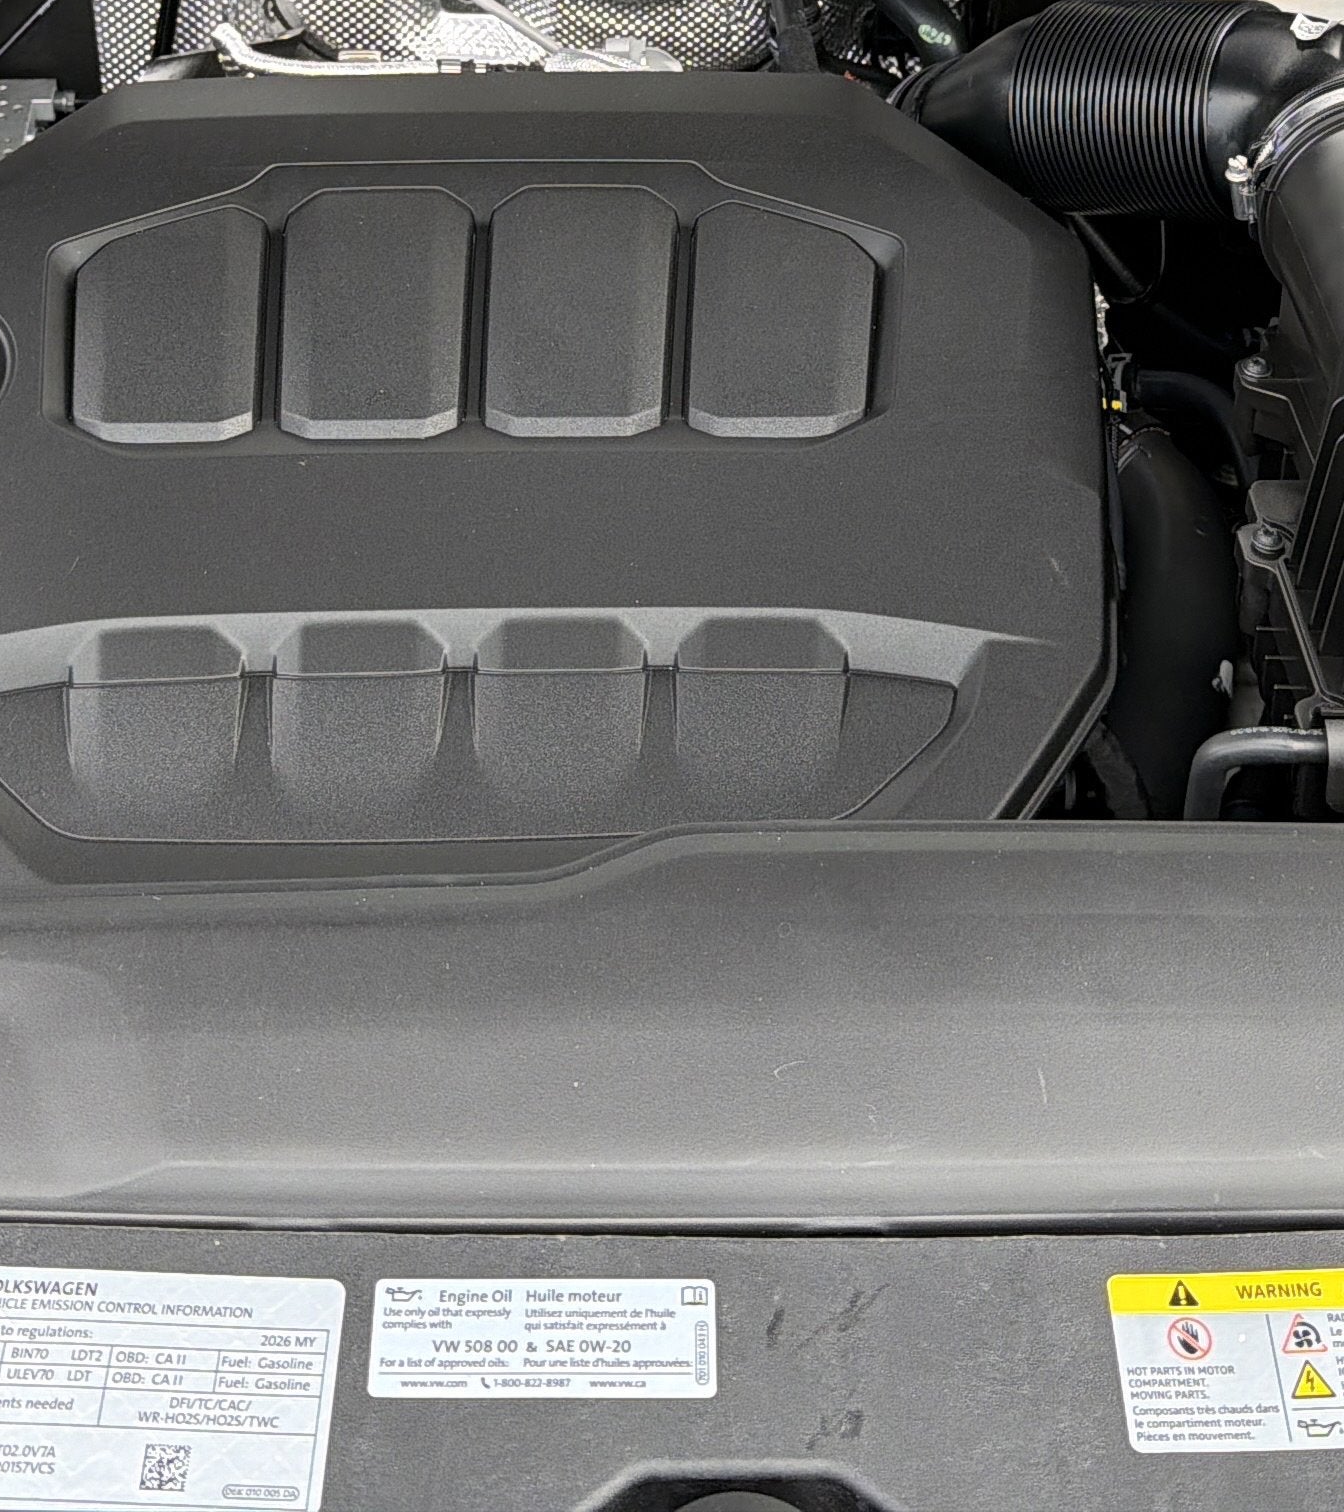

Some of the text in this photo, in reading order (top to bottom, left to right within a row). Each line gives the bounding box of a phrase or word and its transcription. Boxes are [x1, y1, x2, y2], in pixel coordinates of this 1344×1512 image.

[525, 1289, 622, 1302] Huile moteur
[1235, 1281, 1321, 1299] WARNING
[439, 1289, 512, 1306] Engine Oil
[30, 1298, 94, 1311] EMISSION
[96, 1300, 157, 1315] CONTROL
[160, 1304, 253, 1318] INFORMATION
[383, 1306, 511, 1319] Use only oil that expressly
[524, 1308, 562, 1318] Utilisez
[564, 1309, 627, 1319] uniquement
[629, 1308, 642, 1318] de
[0, 1324, 14, 1335] to
[16, 1325, 93, 1339] regulations:
[381, 1319, 452, 1331] complies with
[524, 1322, 541, 1331] qui
[542, 1319, 583, 1330] satisfait
[1329, 1326, 1342, 1336] Le
[260, 1334, 317, 1347] 2026 MY
[431, 1339, 631, 1352] VW 508 00 & SAE 0W-20
[10, 1346, 49, 1359] BIN70
[70, 1348, 103, 1362] LDT2
[115, 1350, 149, 1363] OBD:
[154, 1352, 173, 1364] CA
[221, 1355, 313, 1370] Fuel: Gasoline
[379, 1357, 396, 1367] For
[397, 1359, 404, 1367] a
[406, 1357, 422, 1367] list
[423, 1356, 436, 1367] of
[436, 1357, 486, 1369] approved
[522, 1357, 546, 1367] Pour
[548, 1359, 568, 1367] une
[569, 1357, 590, 1367] liste
[6, 1368, 54, 1380] ULEV70
[66, 1369, 92, 1381] LDT
[1126, 1364, 1235, 1376] HOT PARTS IN MOTOR
[111, 1371, 145, 1384] OBD:
[151, 1373, 170, 1385] CA
[218, 1376, 310, 1391] Fuel: Gasoline
[1128, 1377, 1208, 1388] COMPARTMENT.
[1130, 1389, 1210, 1400] MOVING PARTS.
[24, 1397, 74, 1410] needed
[1132, 1405, 1195, 1417] Composants
[1217, 1403, 1254, 1414] chauds
[1254, 1402, 1280, 1413] dans
[1134, 1418, 1265, 1429] le compartiment moteur.
[1172, 1433, 1185, 1441] en
[1187, 1430, 1255, 1440] mouvement.
